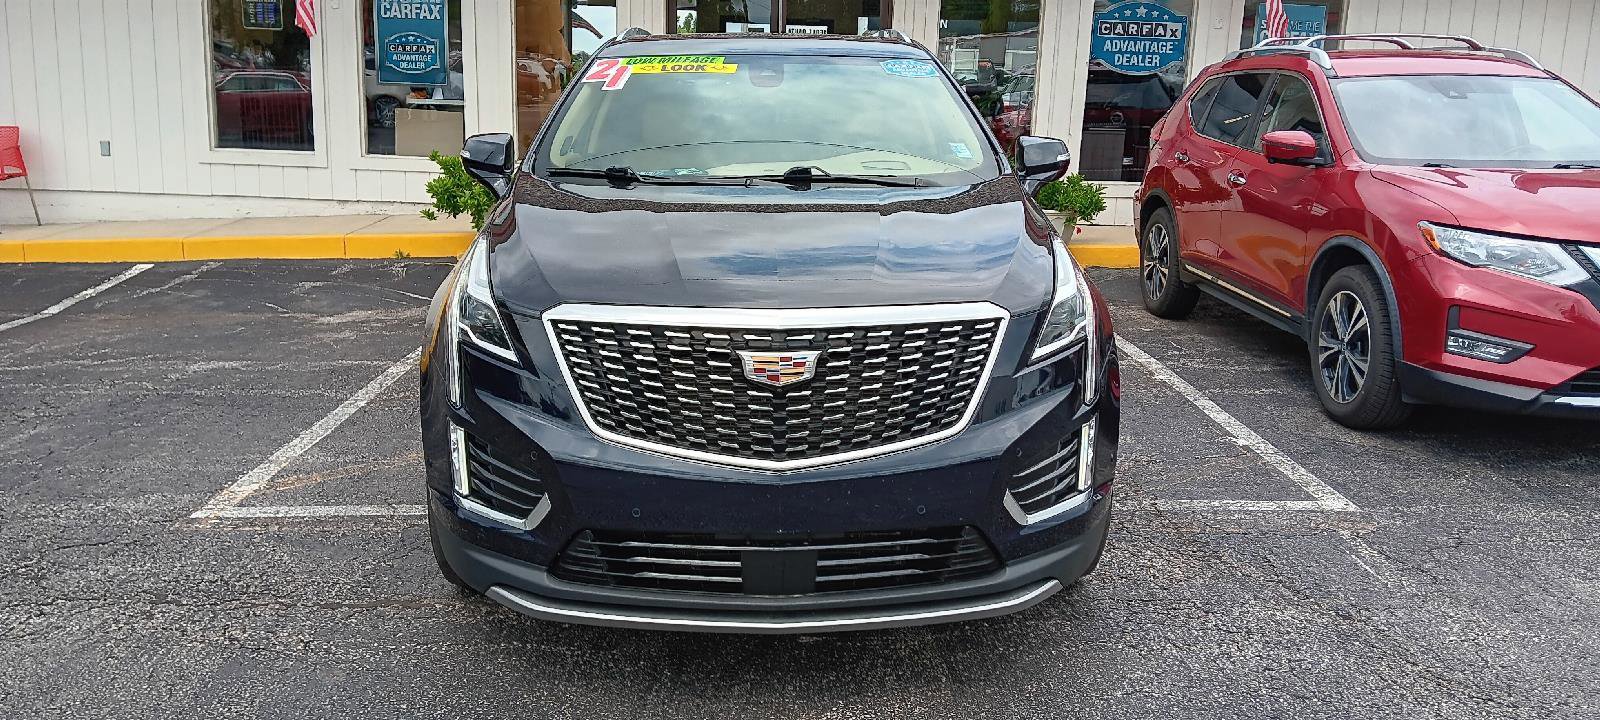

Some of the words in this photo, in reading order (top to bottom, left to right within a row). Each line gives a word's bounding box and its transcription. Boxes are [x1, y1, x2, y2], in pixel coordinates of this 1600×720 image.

[381, 3, 442, 19] CARFAX
[1101, 23, 1179, 38] CARFAX
[389, 44, 435, 53] CARFAX
[1103, 40, 1174, 53] ADVANTAGE
[626, 57, 655, 65] LOW
[658, 56, 718, 64] MILEAGE
[1114, 54, 1160, 66] DEALER
[586, 59, 629, 88] 21
[661, 64, 707, 72] LOOK
